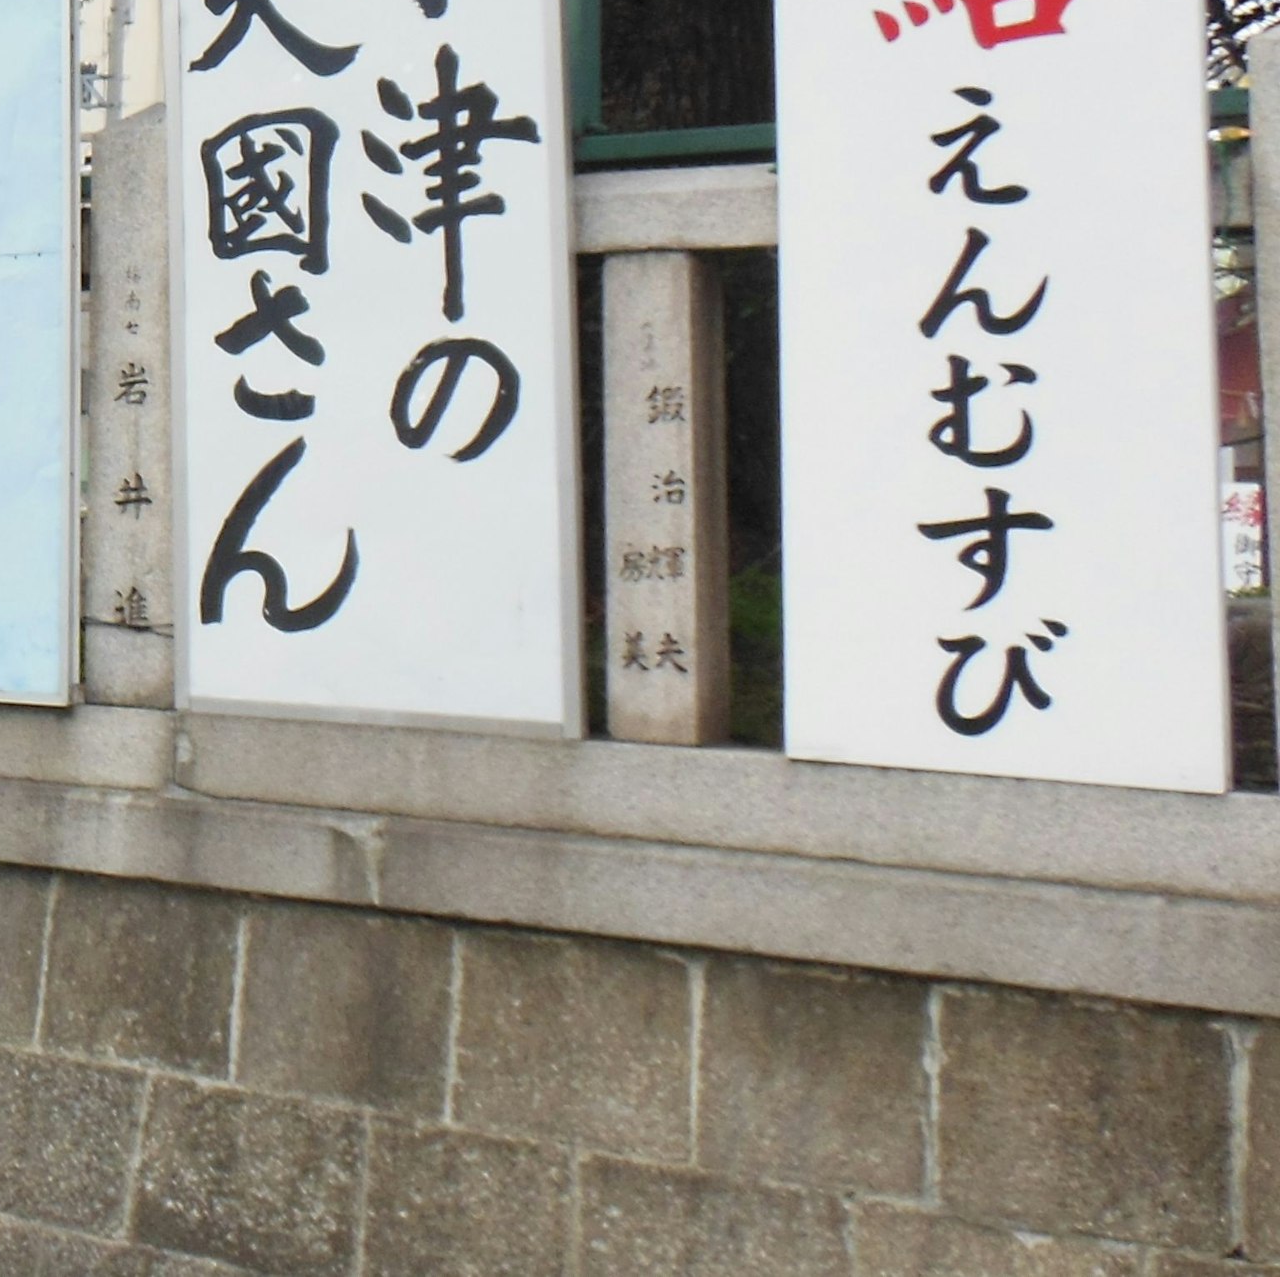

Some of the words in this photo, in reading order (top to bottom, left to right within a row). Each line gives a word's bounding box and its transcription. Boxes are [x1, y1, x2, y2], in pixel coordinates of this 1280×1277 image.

[113, 362, 153, 624] 岩井進
[917, 85, 1069, 739] えんむすび
